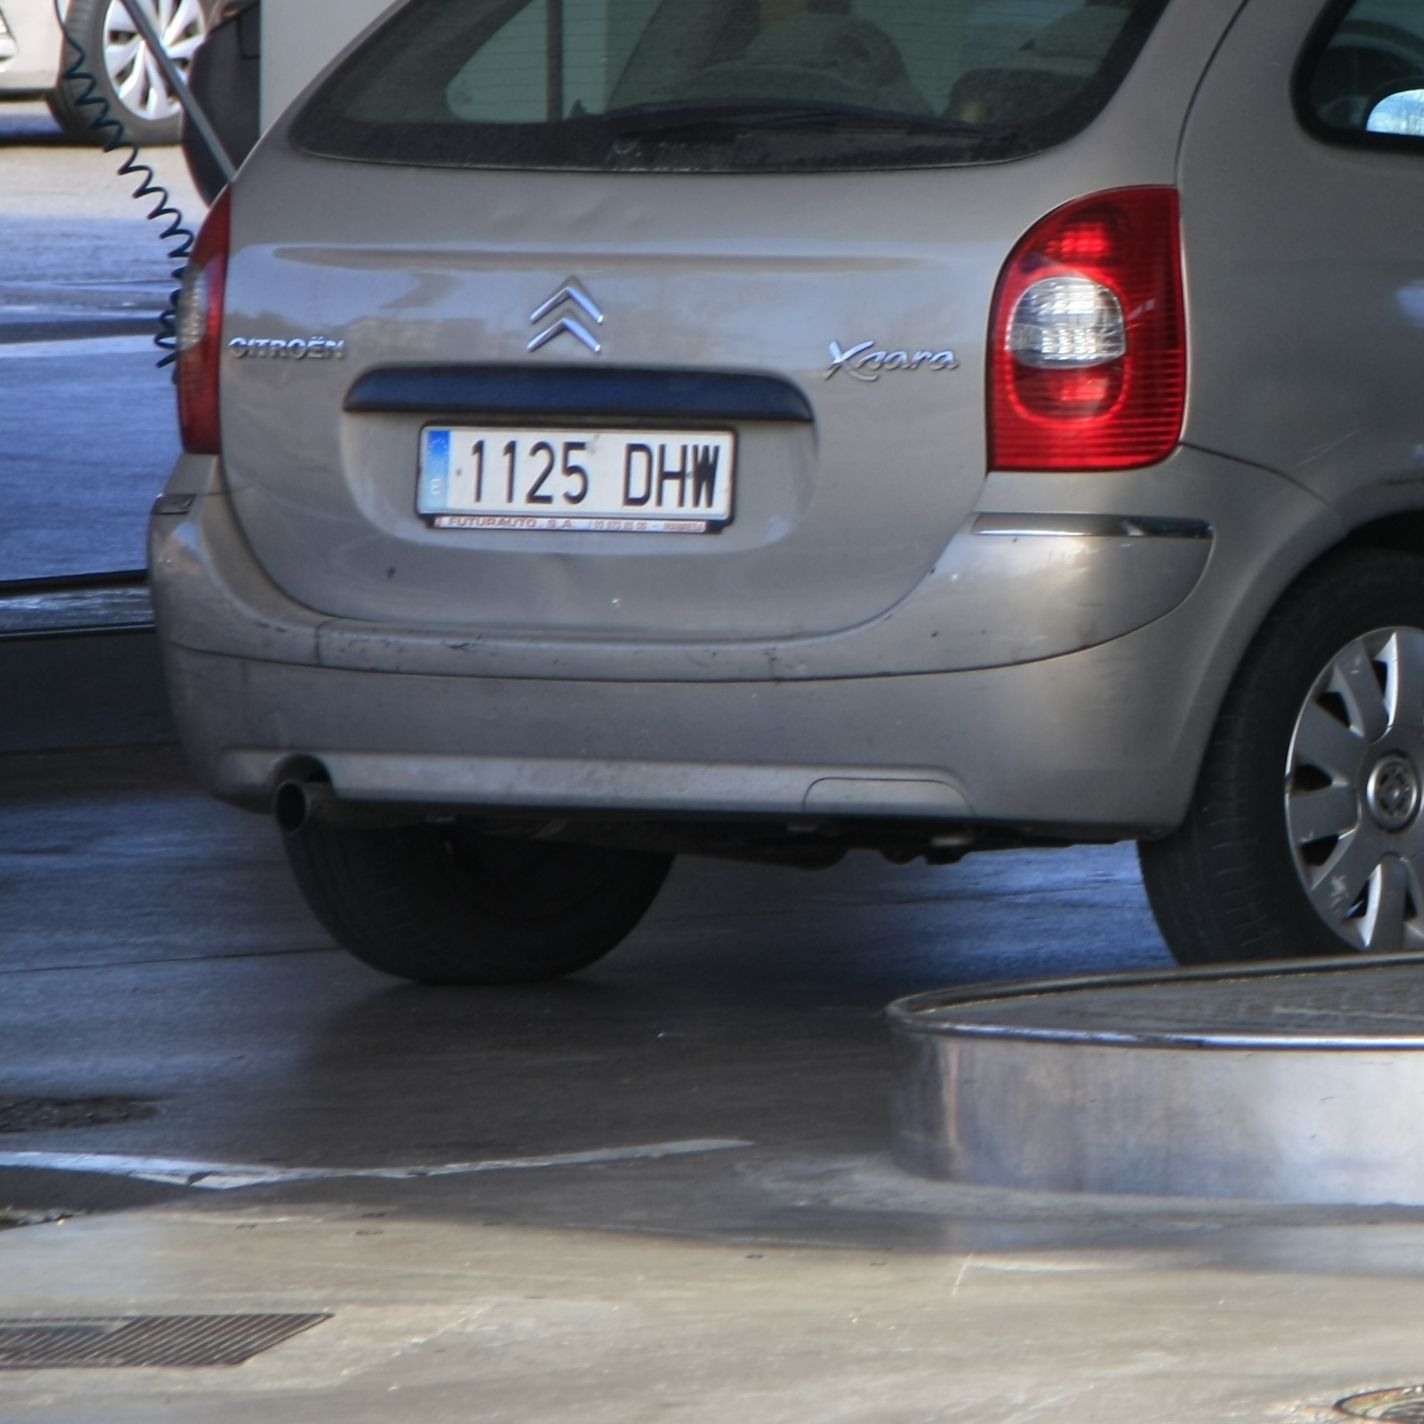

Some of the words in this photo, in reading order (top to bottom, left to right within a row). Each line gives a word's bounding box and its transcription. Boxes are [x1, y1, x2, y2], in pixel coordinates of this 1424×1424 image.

[229, 336, 344, 360] CITROËN
[472, 439, 588, 504] 1125
[622, 443, 720, 508] DHW
